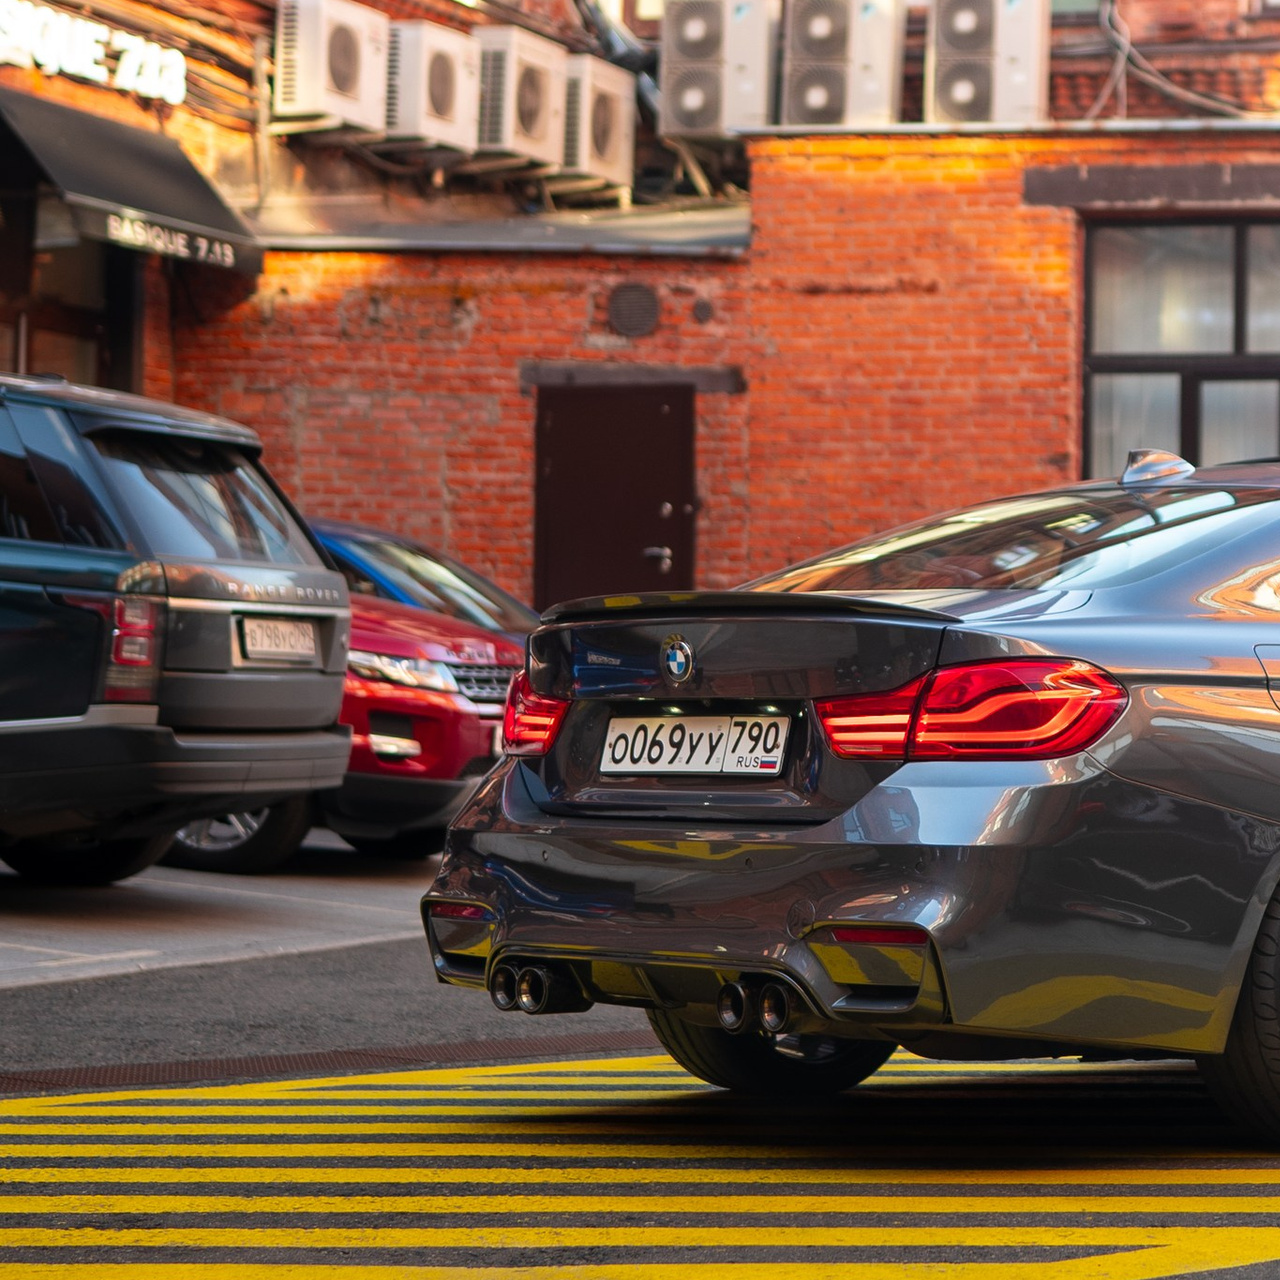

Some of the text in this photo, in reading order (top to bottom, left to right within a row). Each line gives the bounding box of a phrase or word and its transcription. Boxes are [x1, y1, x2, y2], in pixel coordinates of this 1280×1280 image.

[107, 214, 190, 258] BASIQUE
[296, 587, 339, 599] ROVER
[736, 756, 759, 768] RUS
